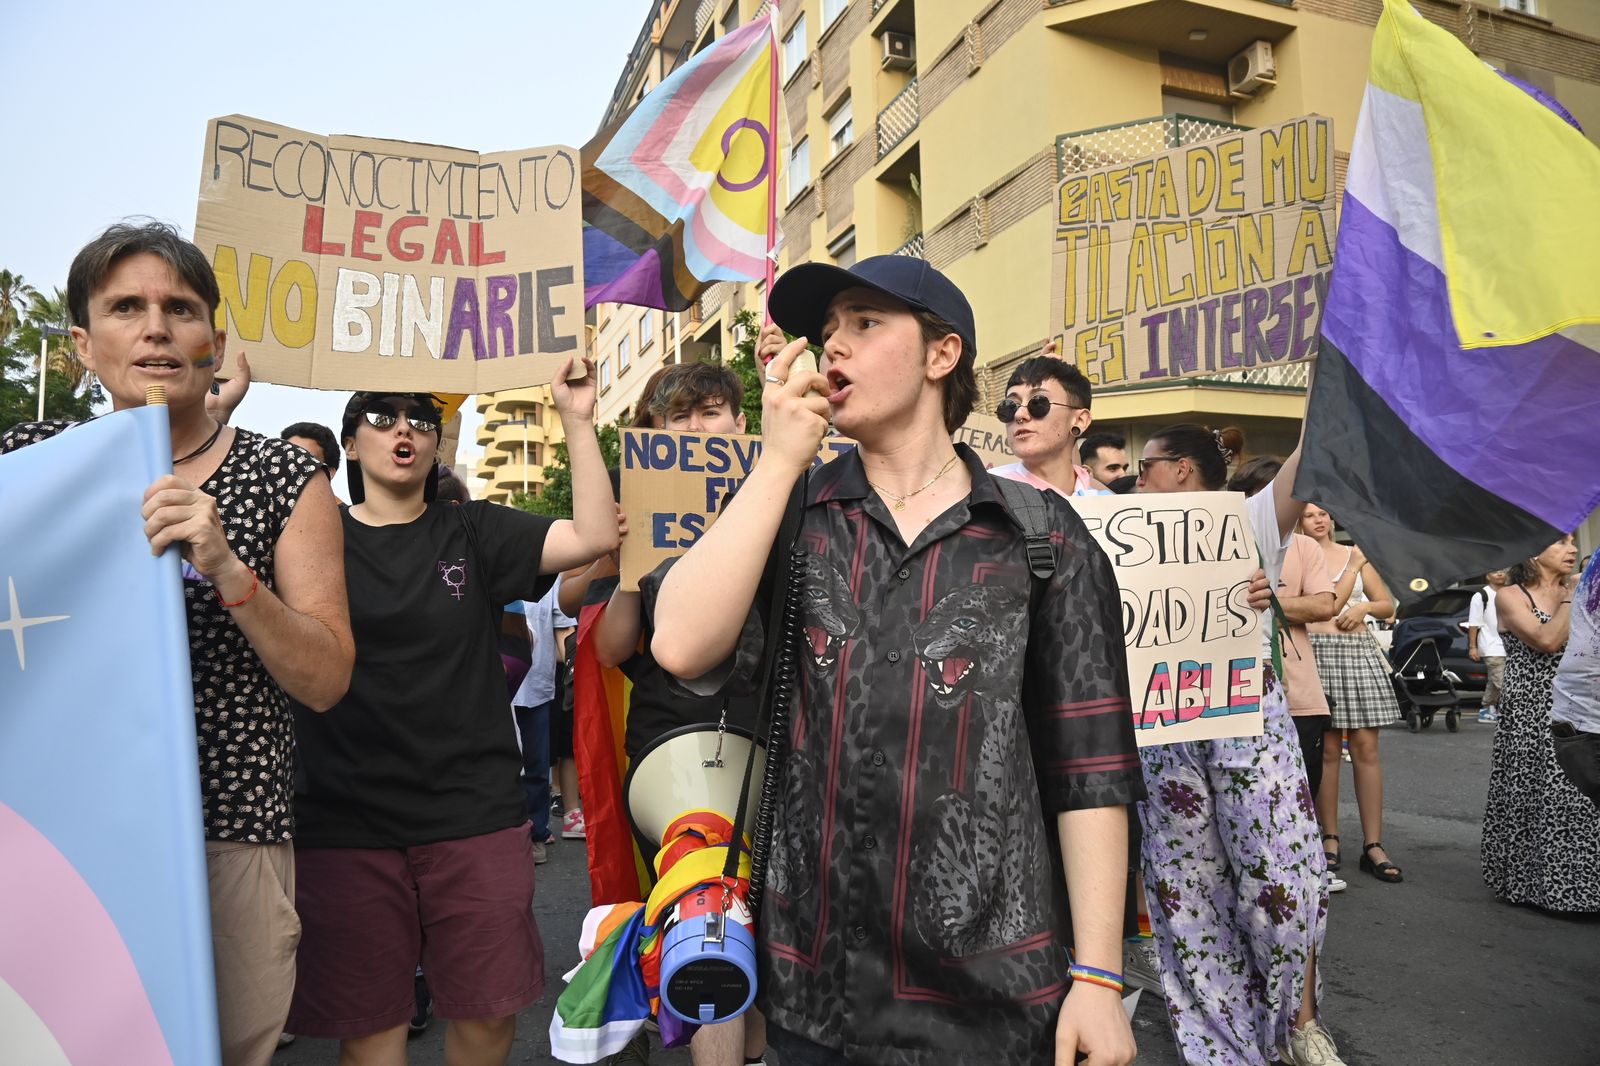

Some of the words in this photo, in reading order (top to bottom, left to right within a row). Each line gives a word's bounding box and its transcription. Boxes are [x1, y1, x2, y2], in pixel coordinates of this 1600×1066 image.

[214, 120, 575, 220] RECONOCIMIENTO
[1058, 155, 1181, 226] BASTA
[1185, 137, 1245, 217] DE
[1260, 119, 1328, 207] MU
[303, 204, 506, 266] LEGAL
[1056, 212, 1275, 330] TILACIÓN
[1287, 206, 1334, 276] A
[213, 244, 319, 349] NO
[331, 266, 578, 360] BINARIE
[1201, 580, 1259, 643] ES
